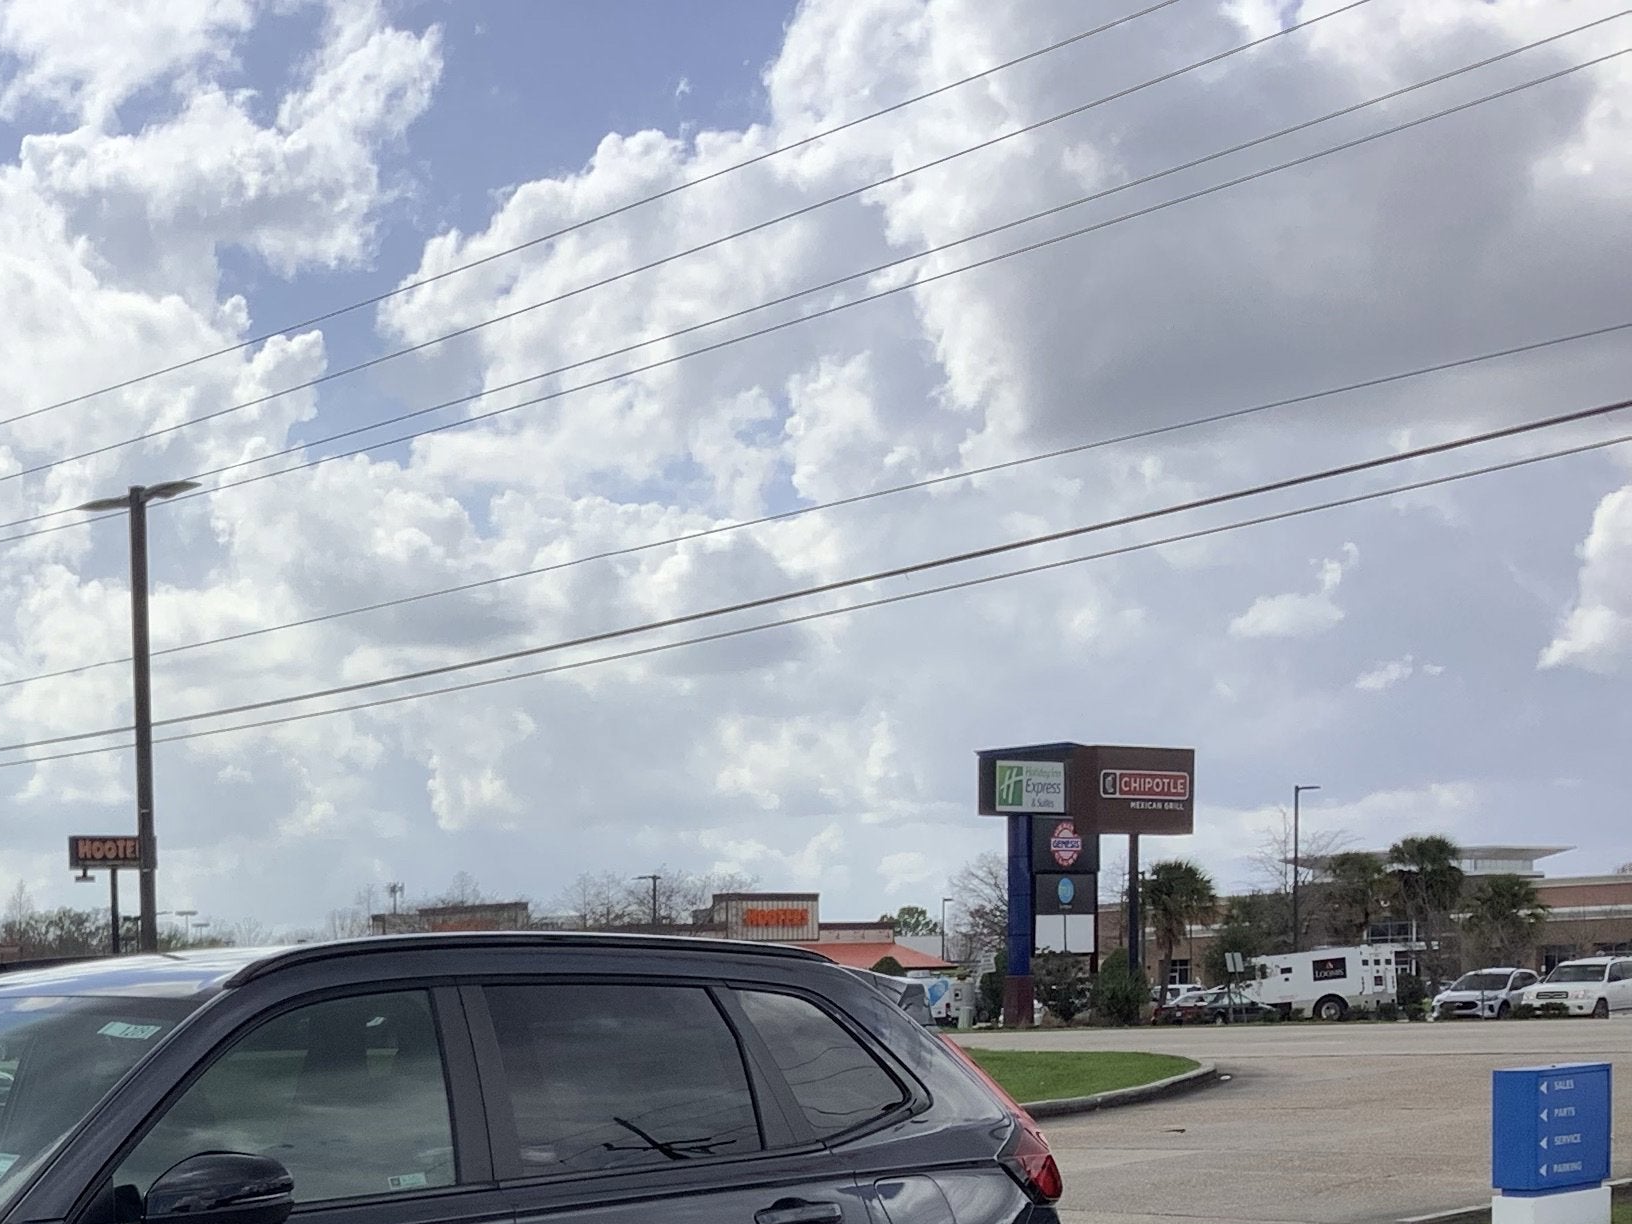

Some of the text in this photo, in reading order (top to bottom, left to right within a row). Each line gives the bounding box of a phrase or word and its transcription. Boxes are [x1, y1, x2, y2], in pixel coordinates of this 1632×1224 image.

[1025, 778, 1060, 797] Express
[1121, 777, 1185, 793] CHIPOTLE
[1130, 801, 1185, 810] MEXICAN GRILL
[1052, 839, 1080, 849] GENESIS
[78, 840, 139, 860] HOOTE
[1315, 969, 1344, 978] LOOMIS
[1554, 1079, 1574, 1090] SALES
[1554, 1107, 1575, 1117] PARTS
[1554, 1134, 1581, 1146] SERVICE
